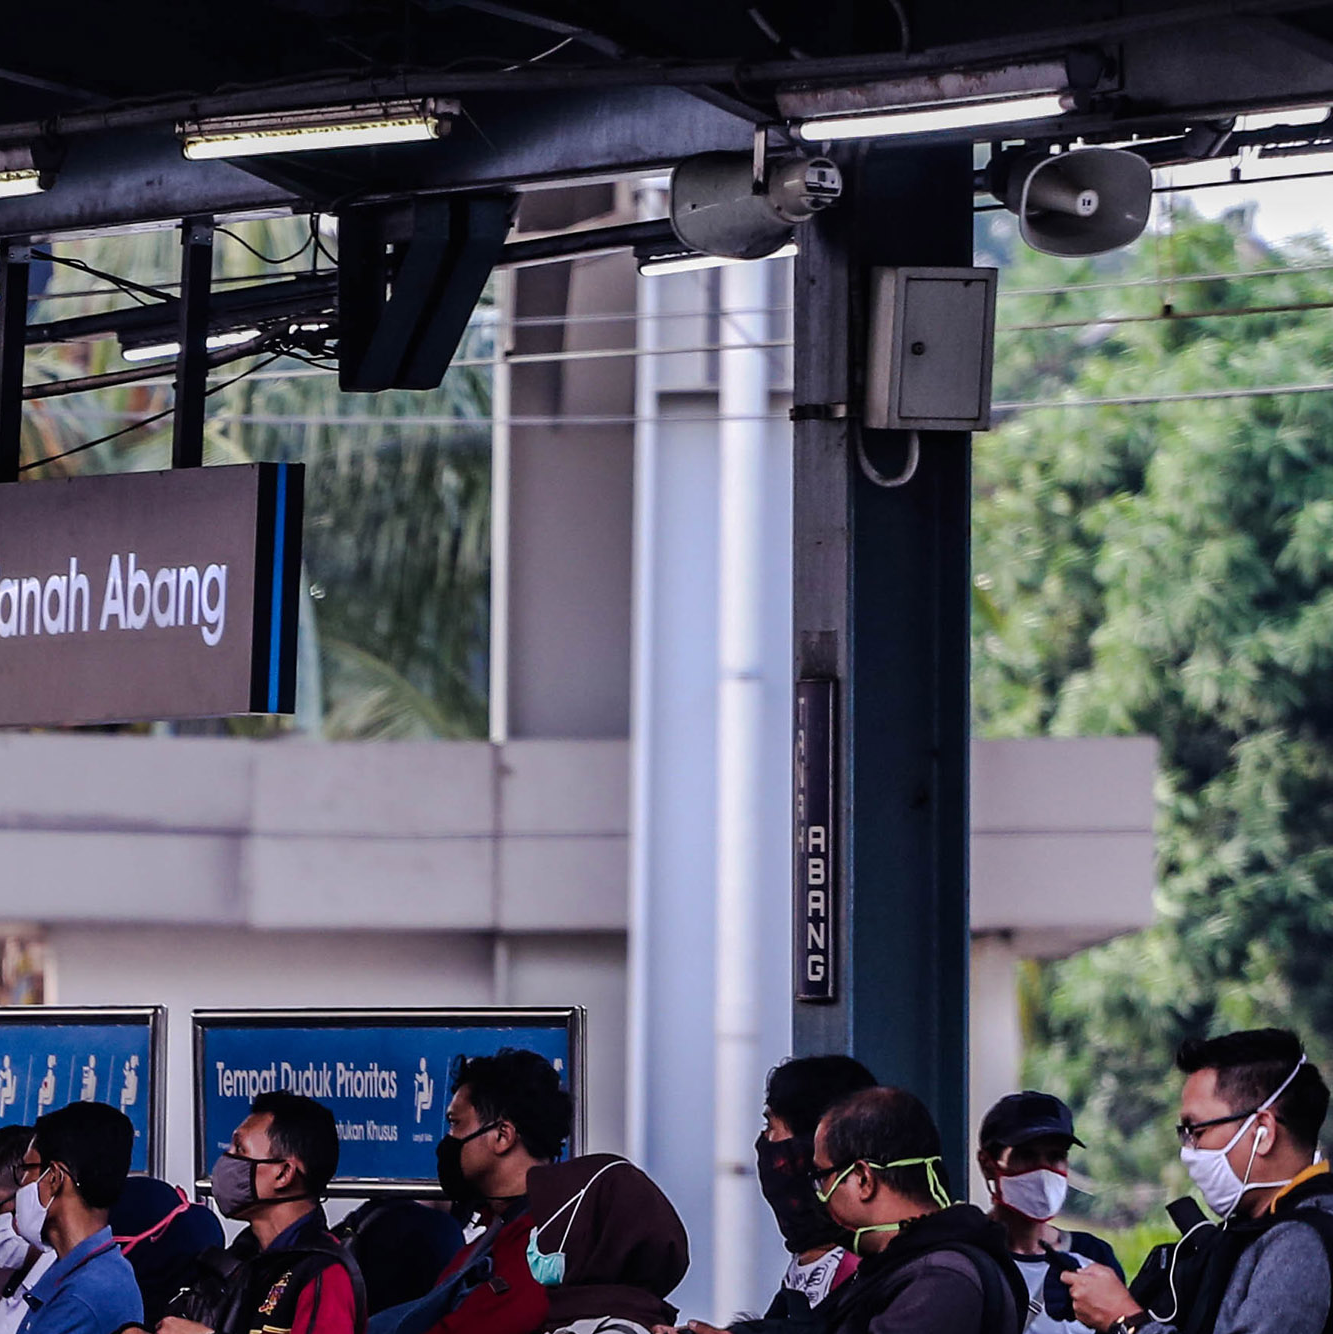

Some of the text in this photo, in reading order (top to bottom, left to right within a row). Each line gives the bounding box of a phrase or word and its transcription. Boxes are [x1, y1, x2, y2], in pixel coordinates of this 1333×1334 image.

[100, 552, 227, 646] Abang
[807, 826, 825, 981] ABANG
[216, 1061, 398, 1105] Tempat Duduk Prioritas
[367, 1120, 398, 1141] Khusus
